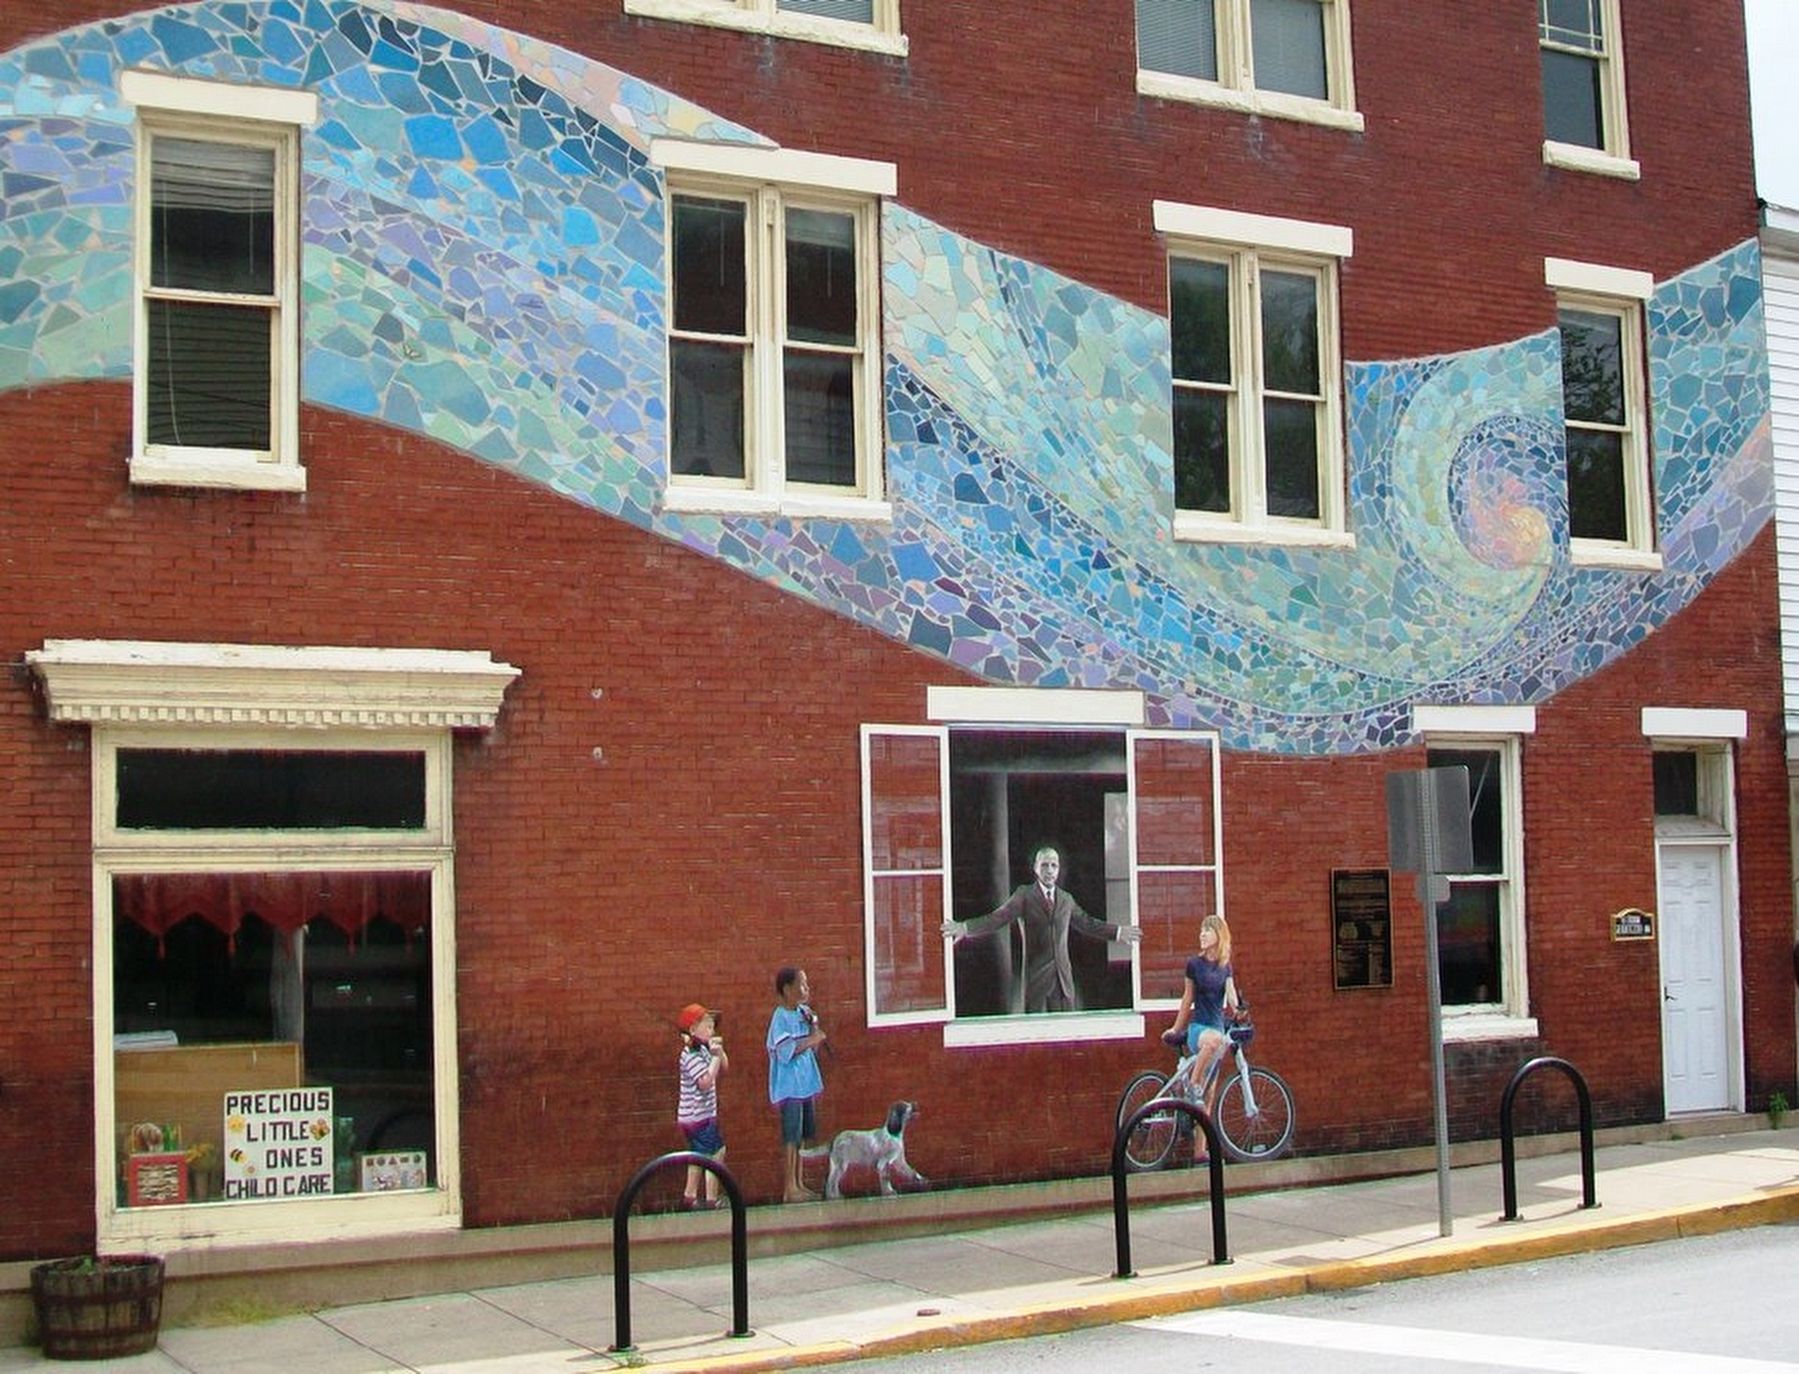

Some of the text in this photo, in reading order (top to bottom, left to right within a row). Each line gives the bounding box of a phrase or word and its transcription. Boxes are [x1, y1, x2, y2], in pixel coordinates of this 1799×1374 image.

[226, 1091, 330, 1115] PRECIOUS
[246, 1120, 309, 1142] LITTLE
[266, 1147, 323, 1169] ONES
[226, 1174, 331, 1199] CHILD CARE
